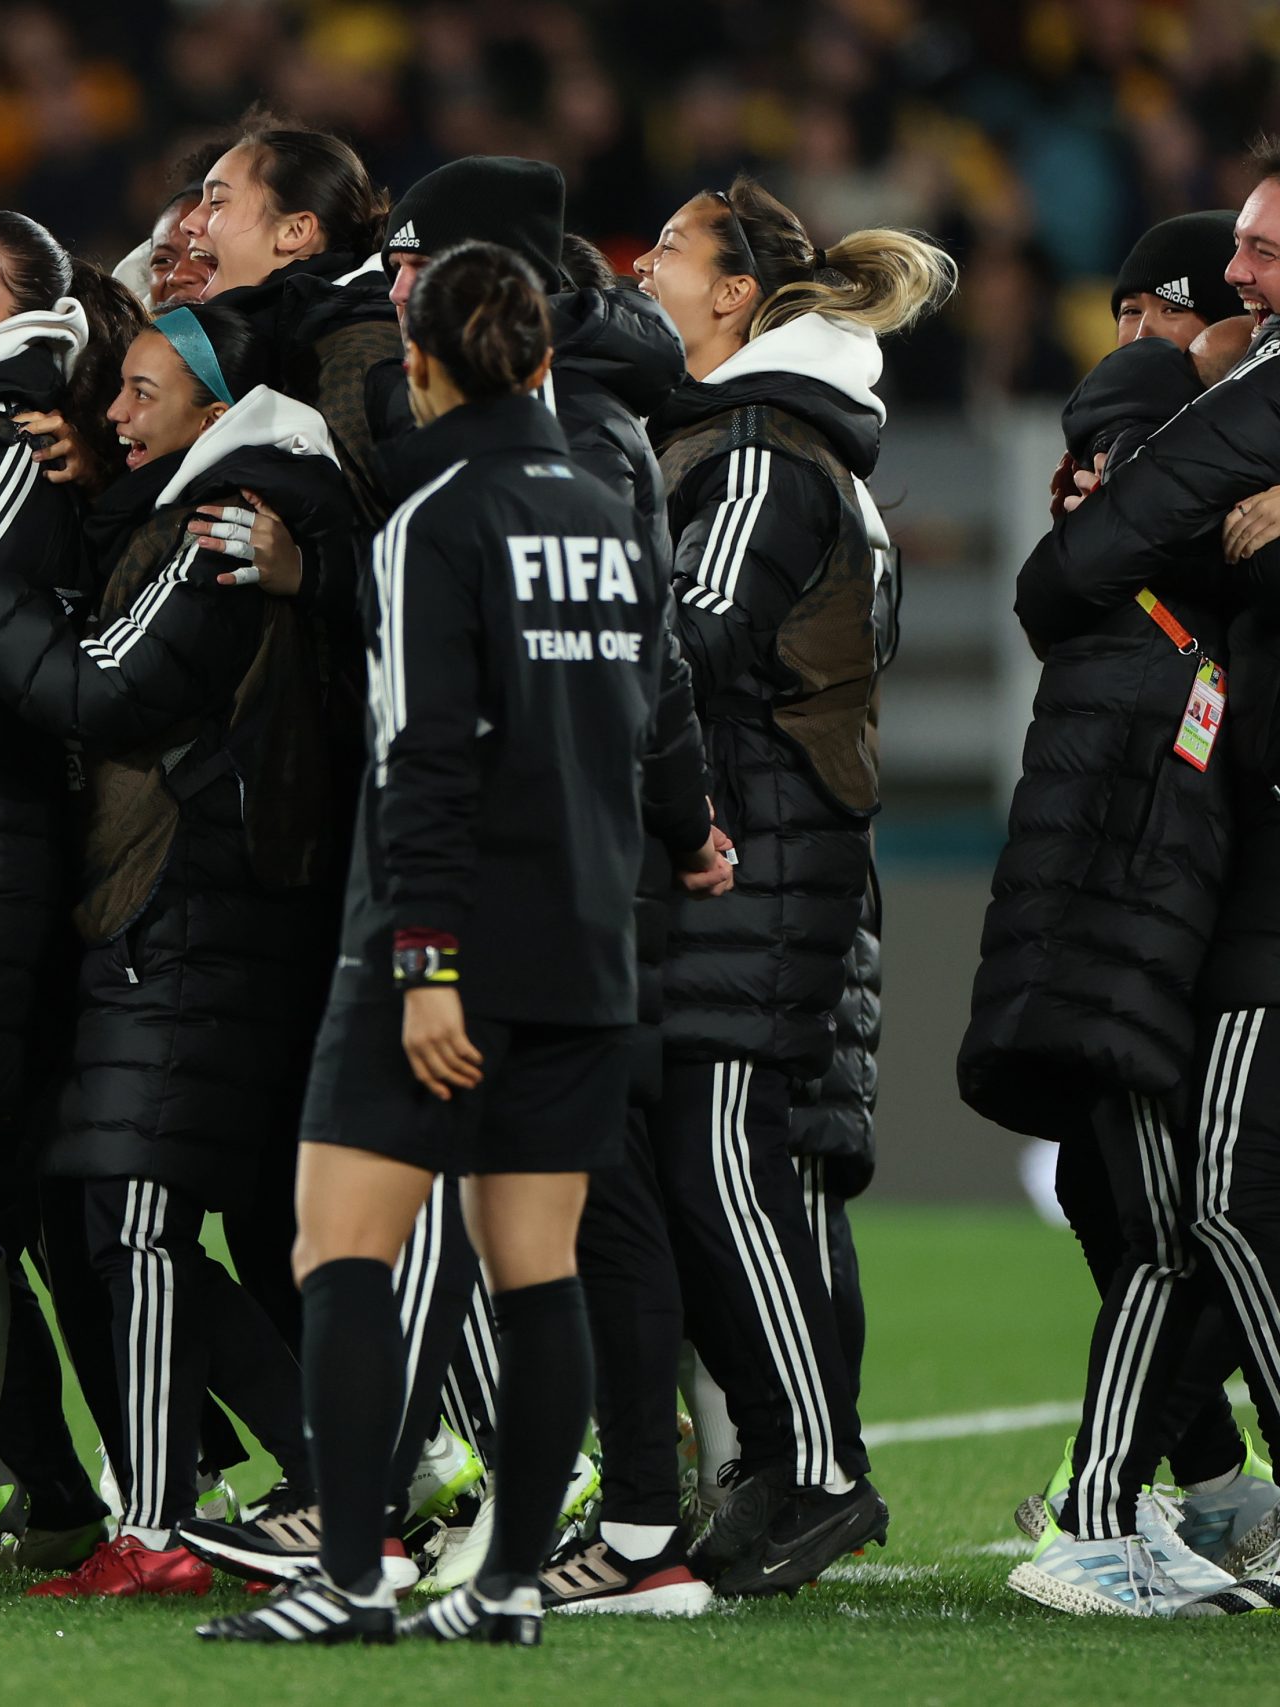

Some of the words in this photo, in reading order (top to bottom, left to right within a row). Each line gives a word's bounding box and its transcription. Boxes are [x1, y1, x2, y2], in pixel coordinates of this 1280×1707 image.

[389, 237, 420, 248] adidas
[1155, 286, 1195, 308] adidas
[523, 630, 593, 660] TEAM
[598, 630, 642, 662] ONE
